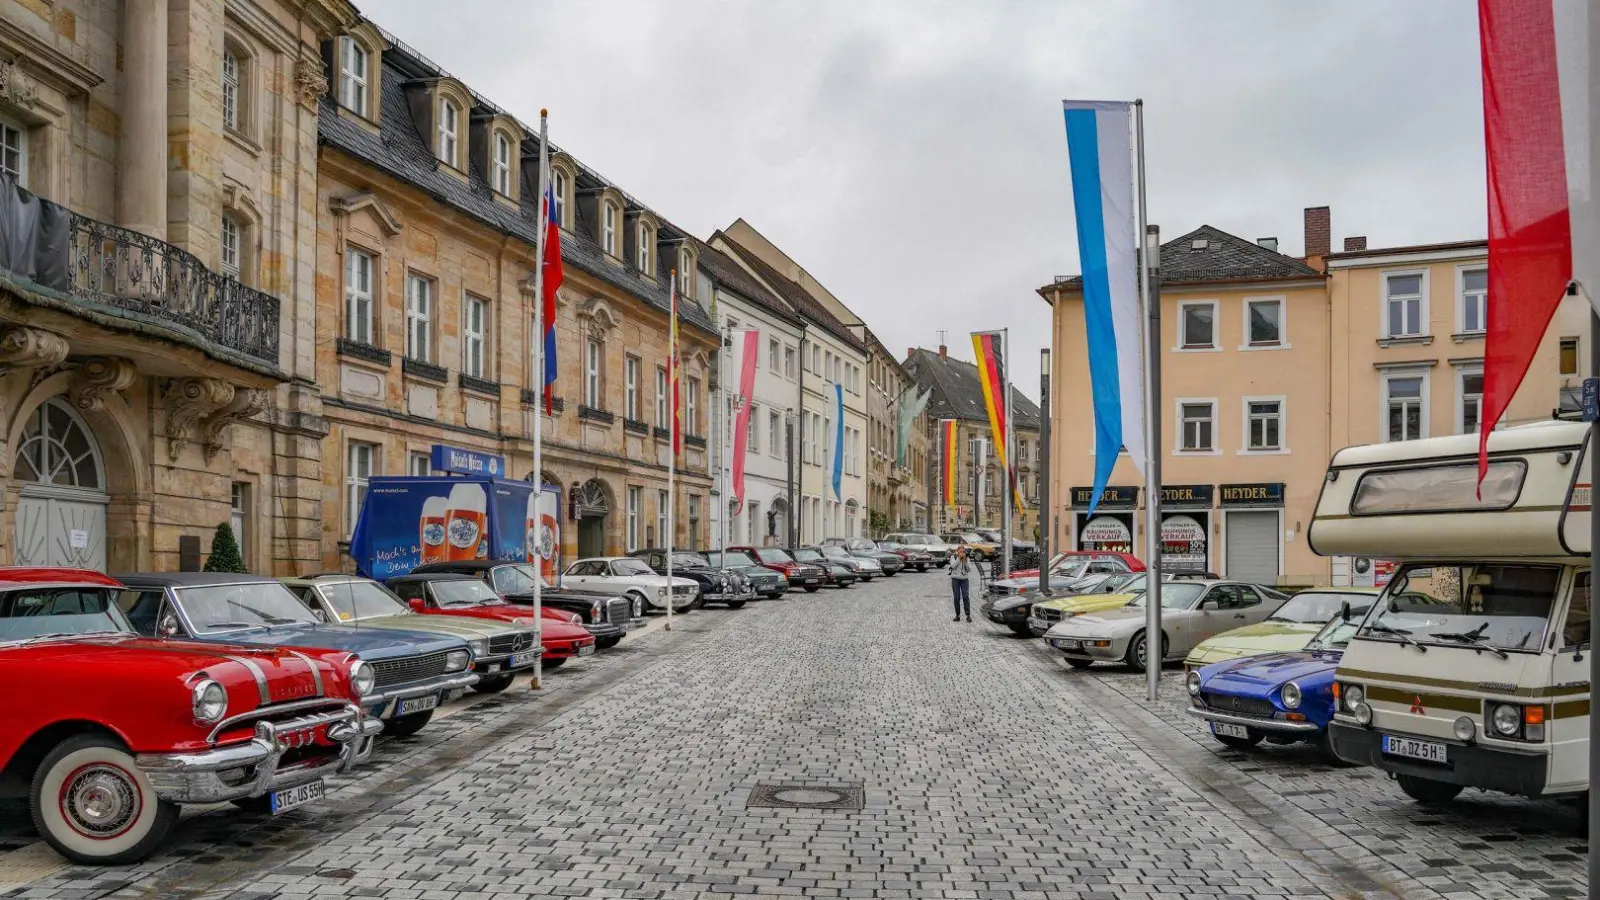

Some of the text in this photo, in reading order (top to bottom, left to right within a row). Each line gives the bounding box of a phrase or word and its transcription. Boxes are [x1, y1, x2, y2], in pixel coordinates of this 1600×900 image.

[1078, 490, 1118, 501] HEDER
[1160, 489, 1193, 500] EYDER
[1224, 487, 1267, 499] HEYDER
[1390, 738, 1402, 753] BT
[1408, 741, 1420, 756] DZ
[277, 790, 293, 809] STE
[297, 786, 309, 802] US
